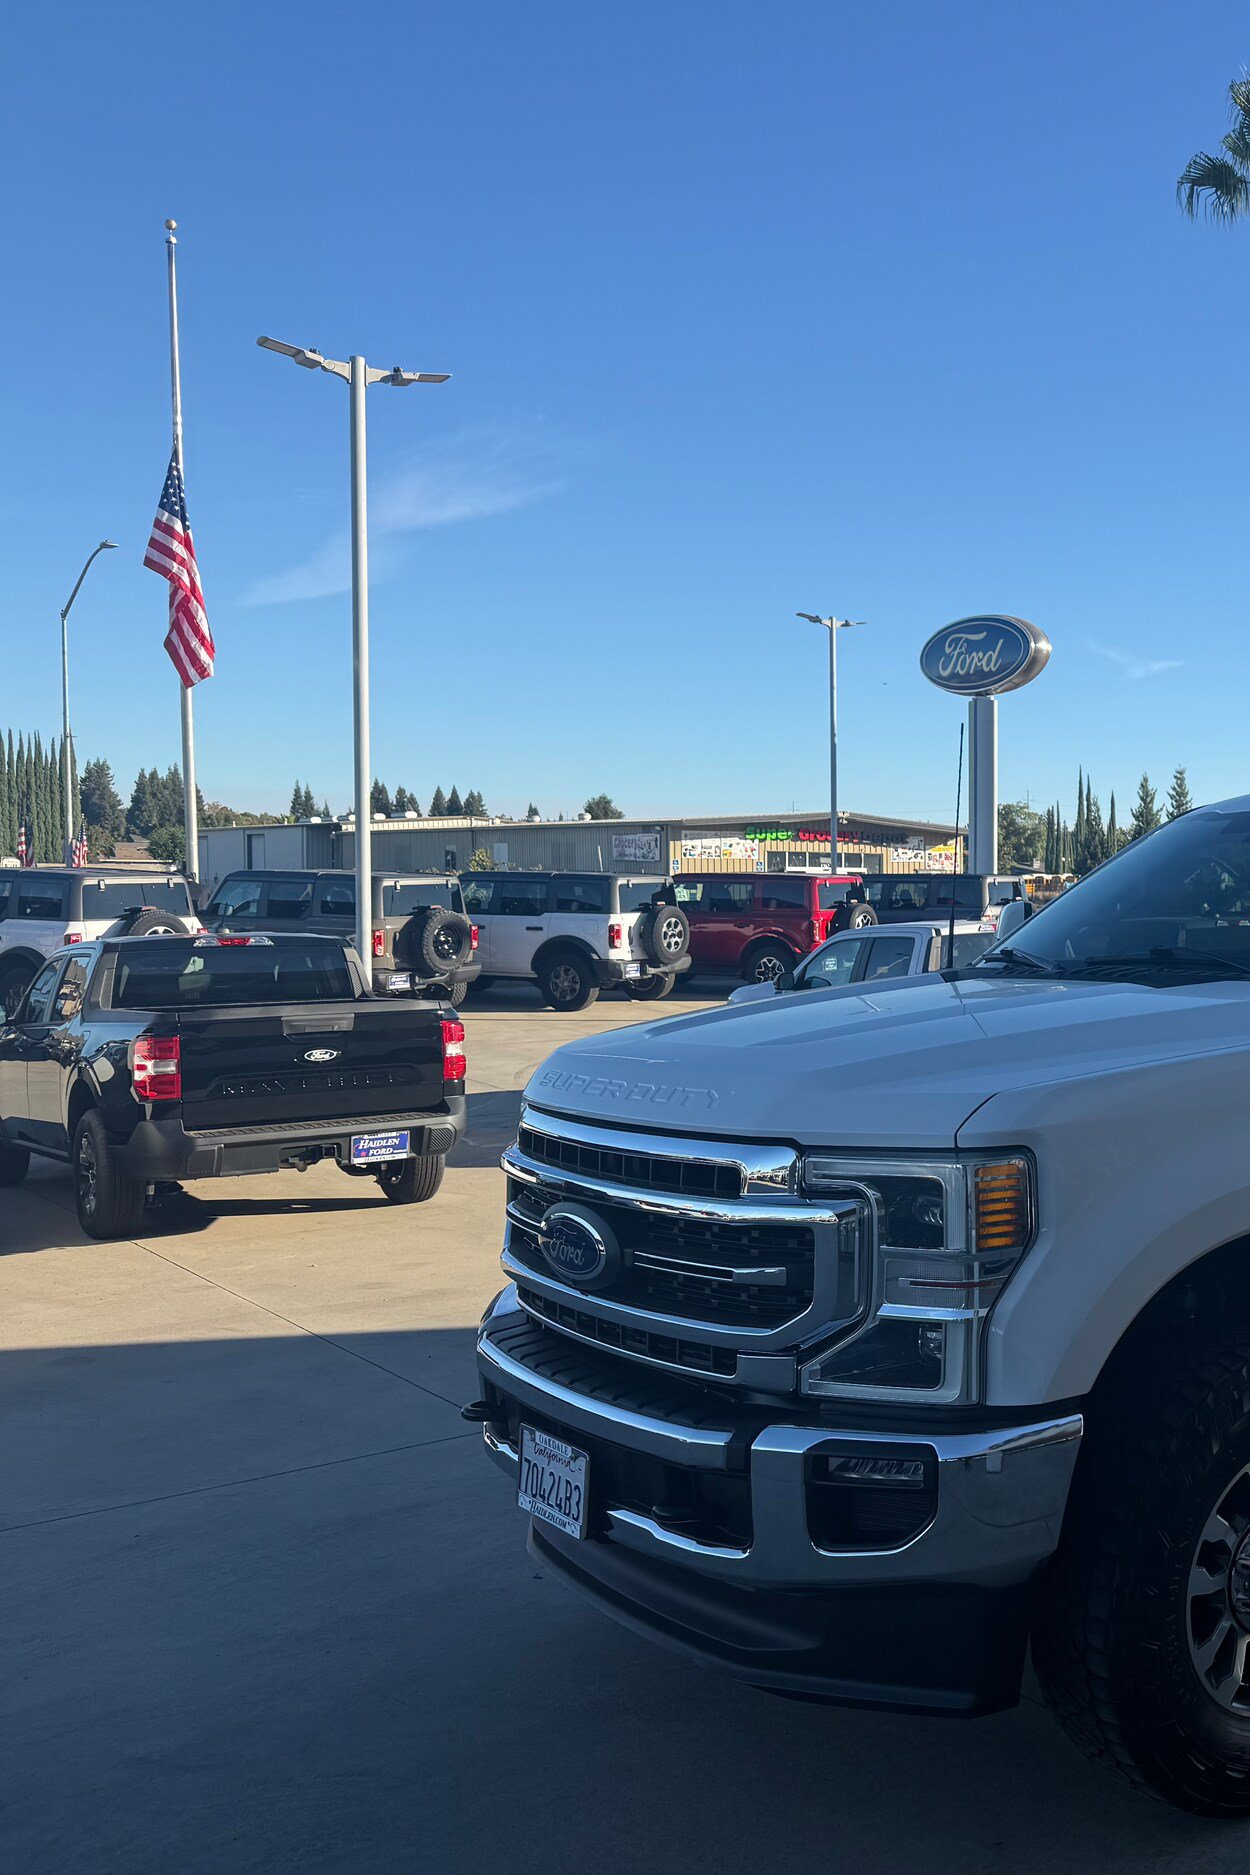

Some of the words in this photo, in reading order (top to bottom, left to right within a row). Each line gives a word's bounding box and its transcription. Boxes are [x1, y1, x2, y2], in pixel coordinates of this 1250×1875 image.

[939, 632, 1004, 677] Ford
[744, 827, 795, 842] Super
[539, 1069, 627, 1099] SUPER
[625, 1082, 719, 1109] DUTY
[358, 1138, 400, 1149] HAIDLEN
[369, 1147, 393, 1156] FORD
[550, 1225, 586, 1266] Ford
[533, 1442, 576, 1473] California
[539, 1433, 569, 1456] OAKDALE
[524, 1456, 581, 1522] 70424B3
